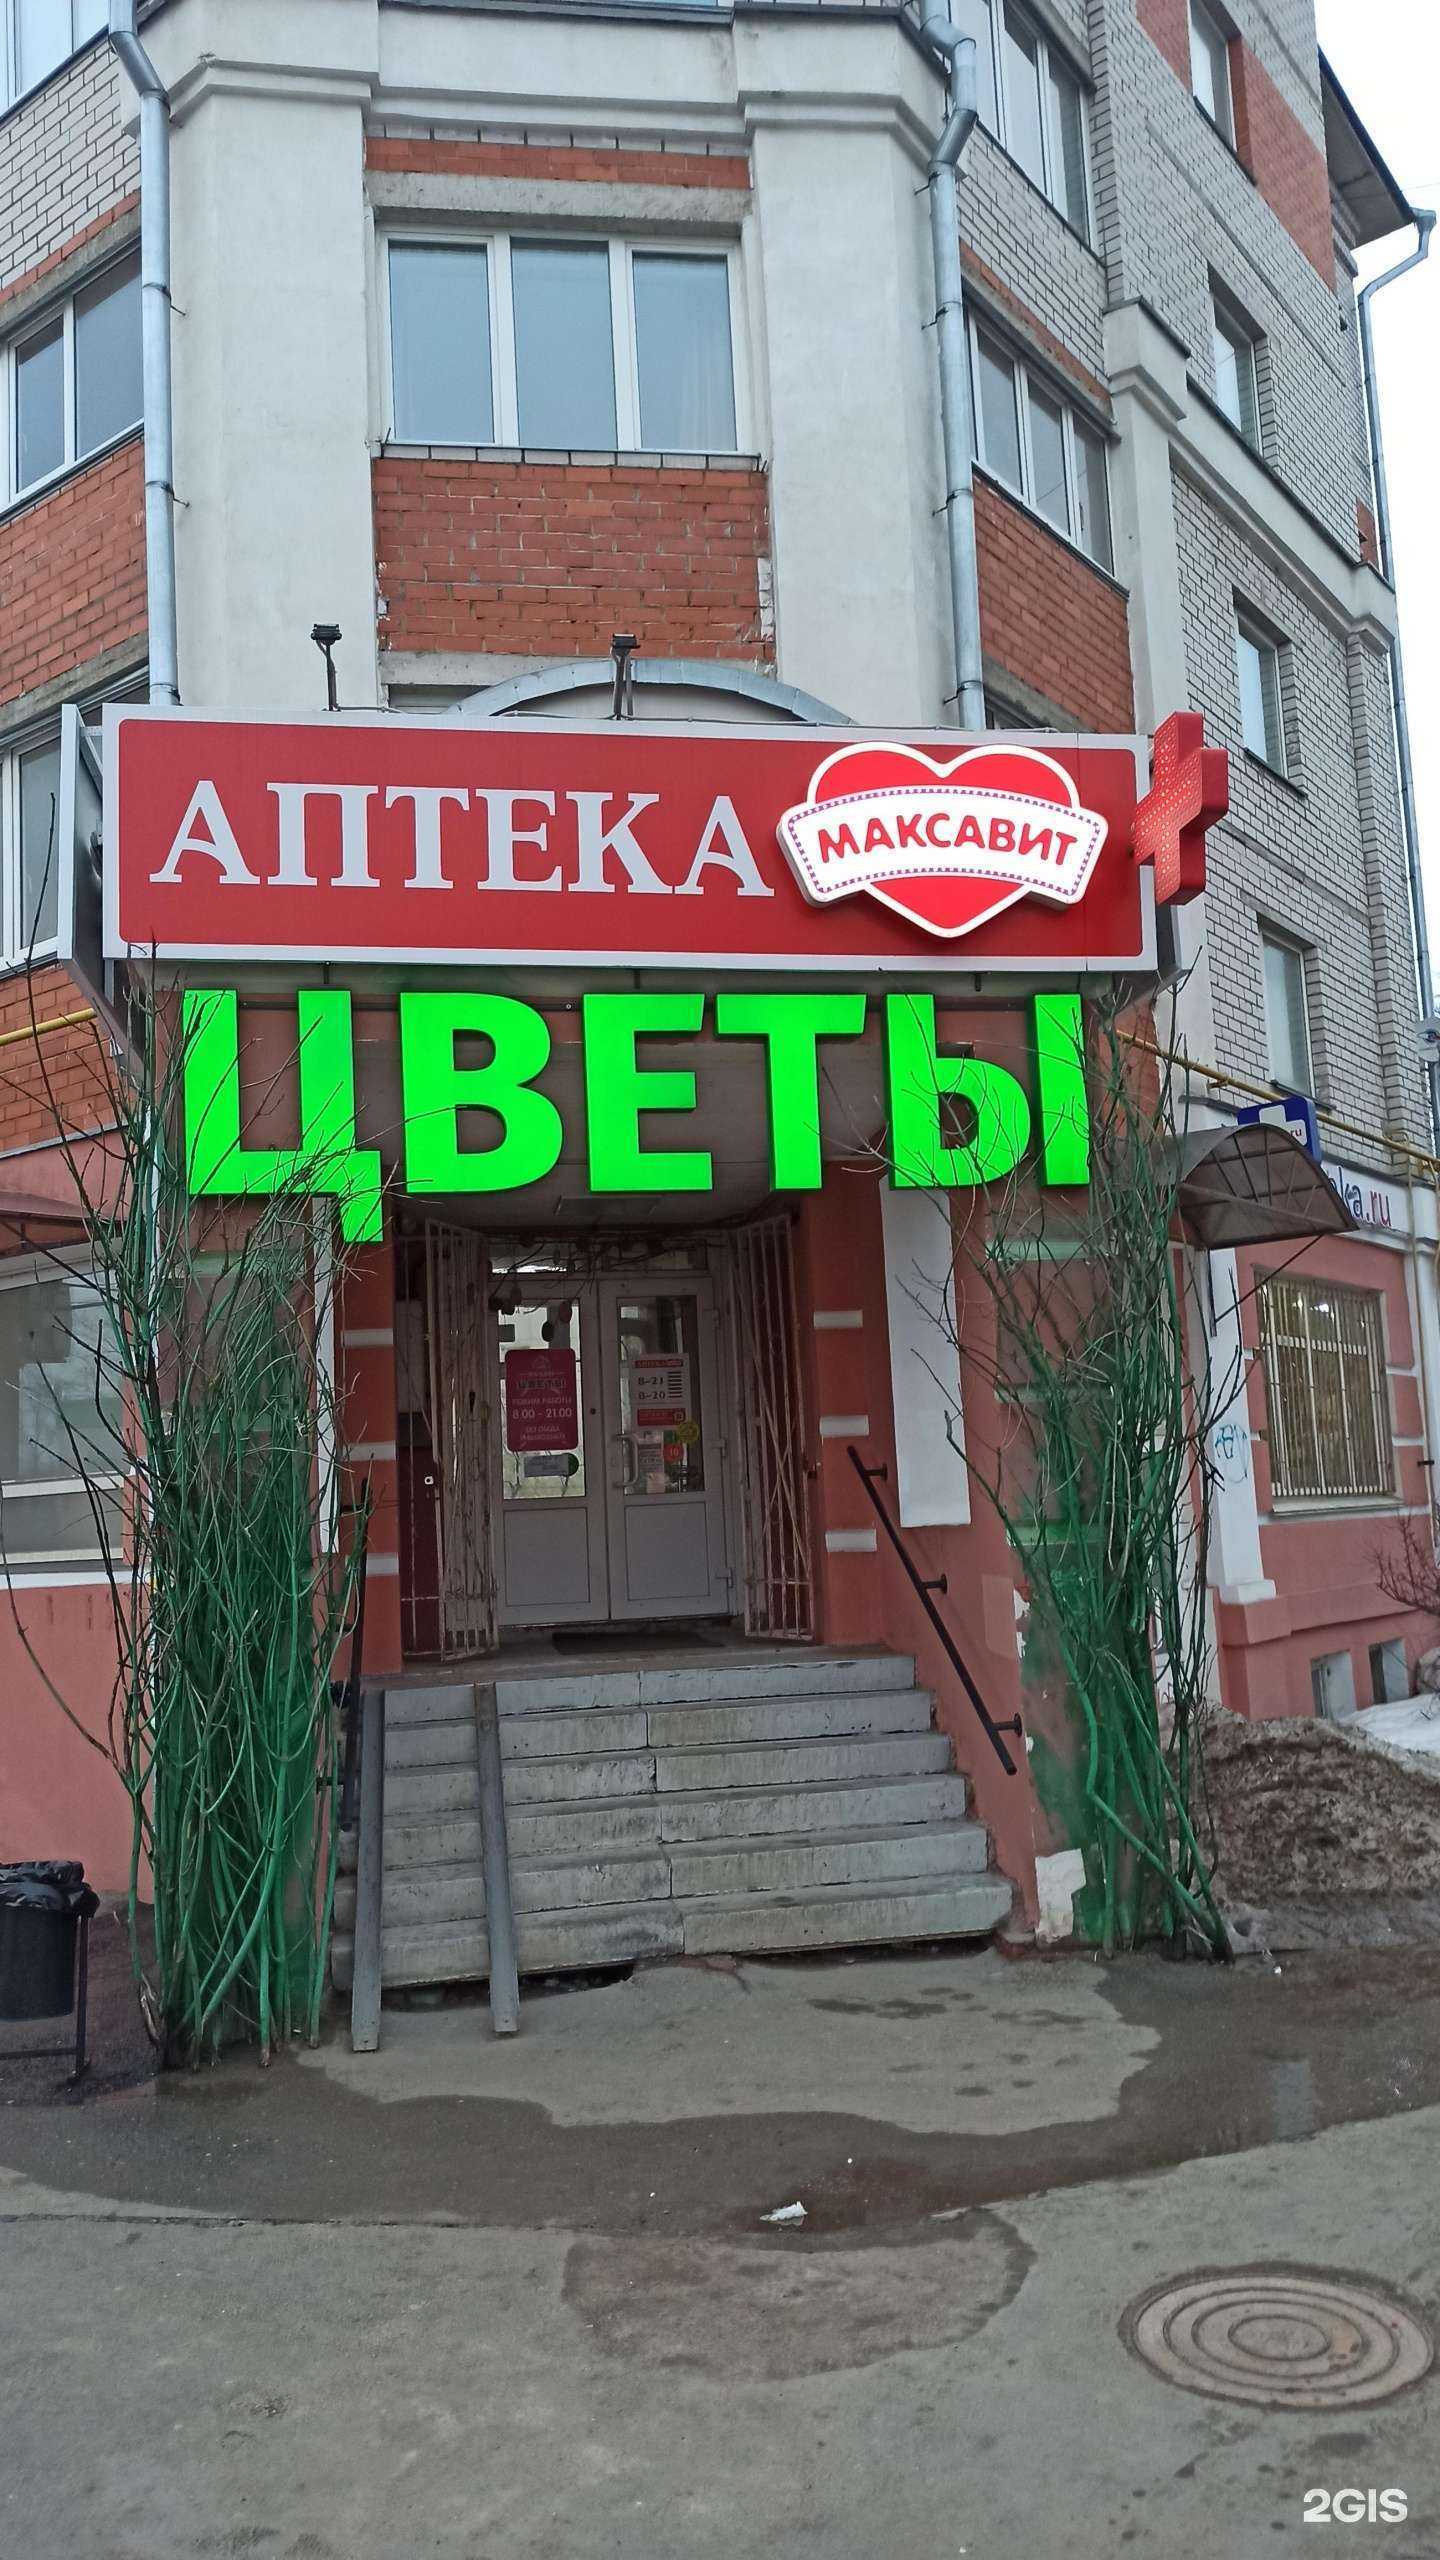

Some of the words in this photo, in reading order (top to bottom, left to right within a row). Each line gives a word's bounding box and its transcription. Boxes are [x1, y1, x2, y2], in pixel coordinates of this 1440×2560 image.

[148, 779, 777, 899] АПТЕКА
[817, 812, 1079, 866] МАКСАВИТ
[185, 991, 1088, 1239] ЦВЕТЫ
